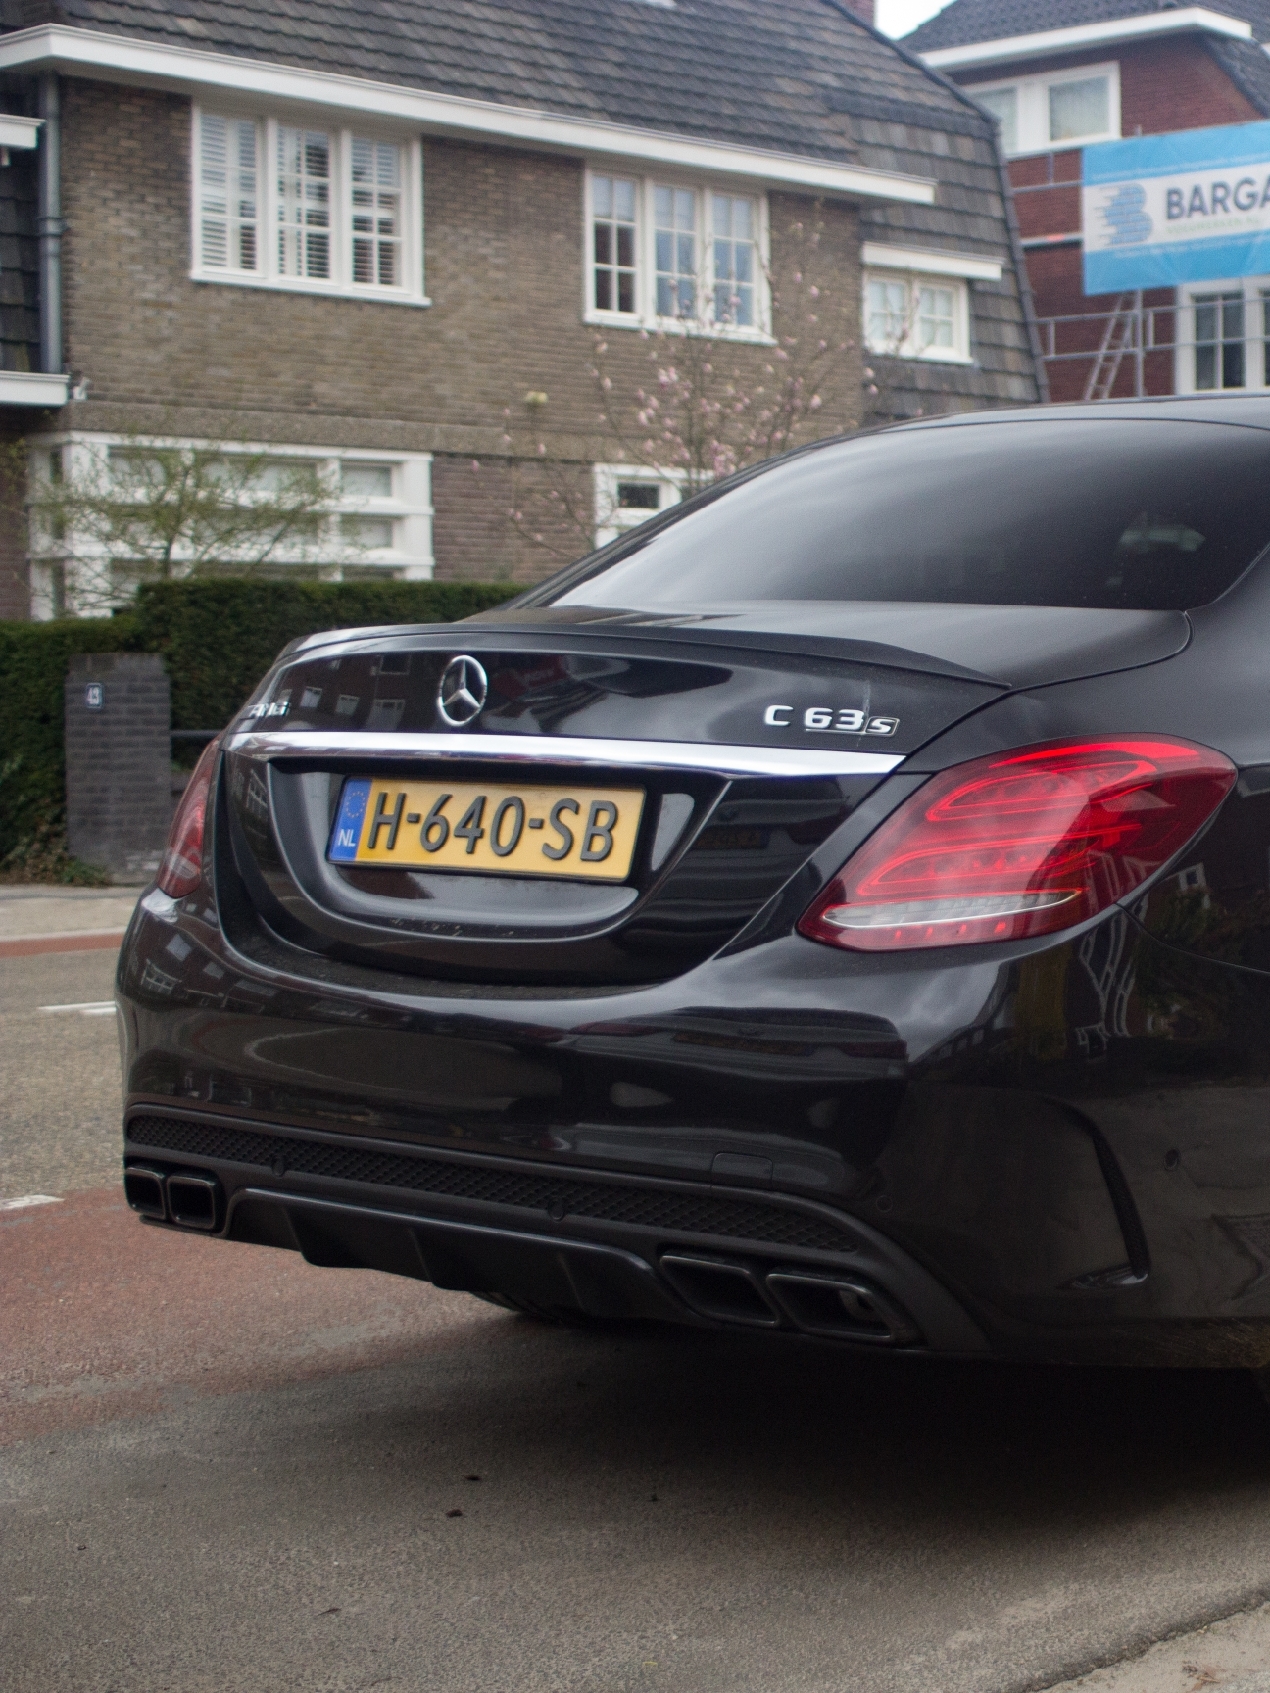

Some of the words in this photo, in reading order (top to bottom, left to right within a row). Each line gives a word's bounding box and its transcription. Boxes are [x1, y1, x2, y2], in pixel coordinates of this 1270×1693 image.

[764, 704, 794, 726] C
[366, 791, 619, 862] H-640-SB
[337, 828, 356, 848] NL
